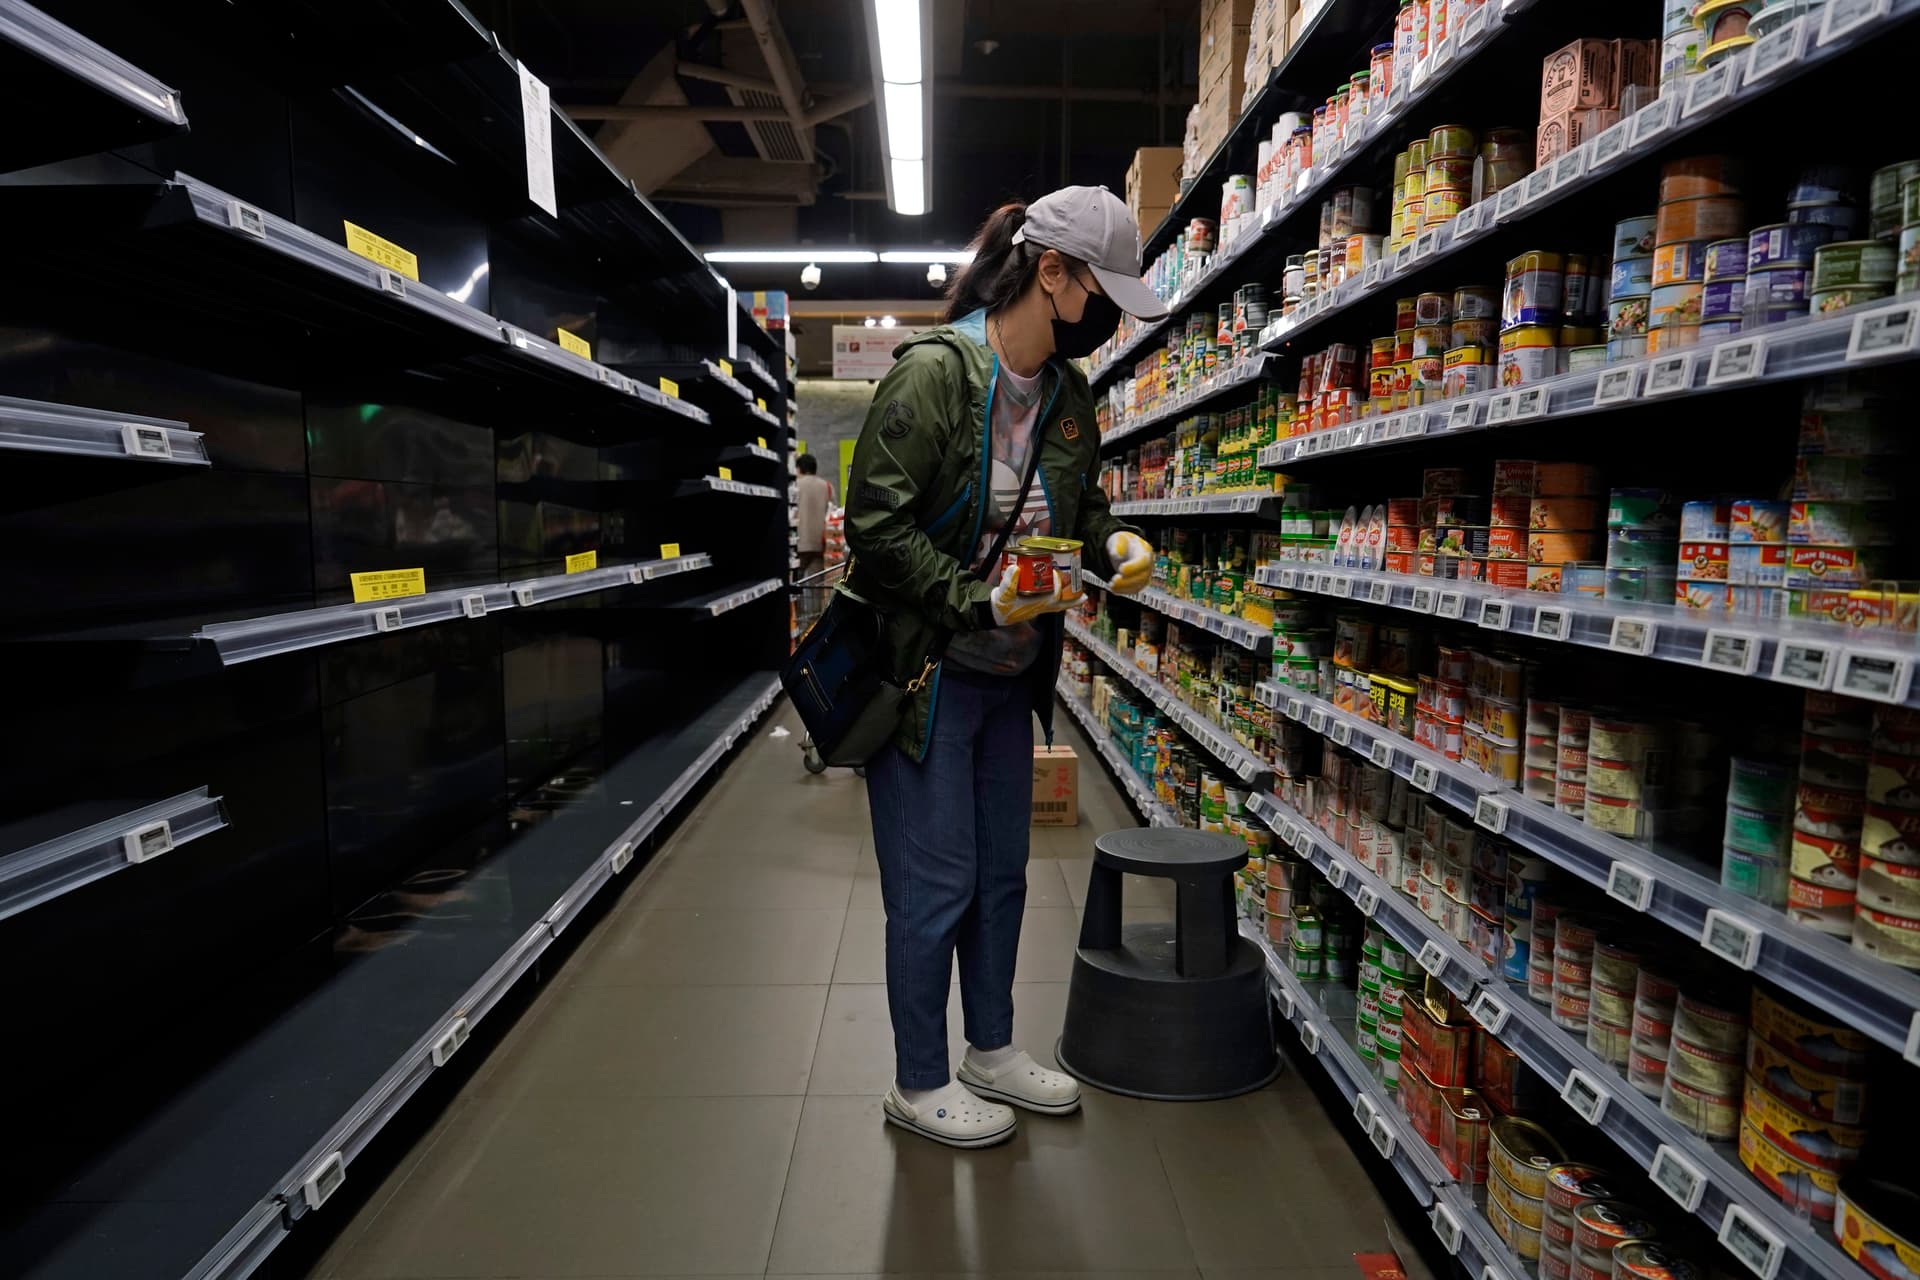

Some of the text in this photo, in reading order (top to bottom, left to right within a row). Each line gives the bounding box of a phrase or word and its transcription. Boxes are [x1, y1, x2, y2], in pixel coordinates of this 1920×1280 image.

[1446, 353, 1463, 366] TULIP
[1818, 551, 1849, 565] BRAND
[1369, 685, 1386, 706] 리챔
[1389, 692, 1406, 716] 리챔
